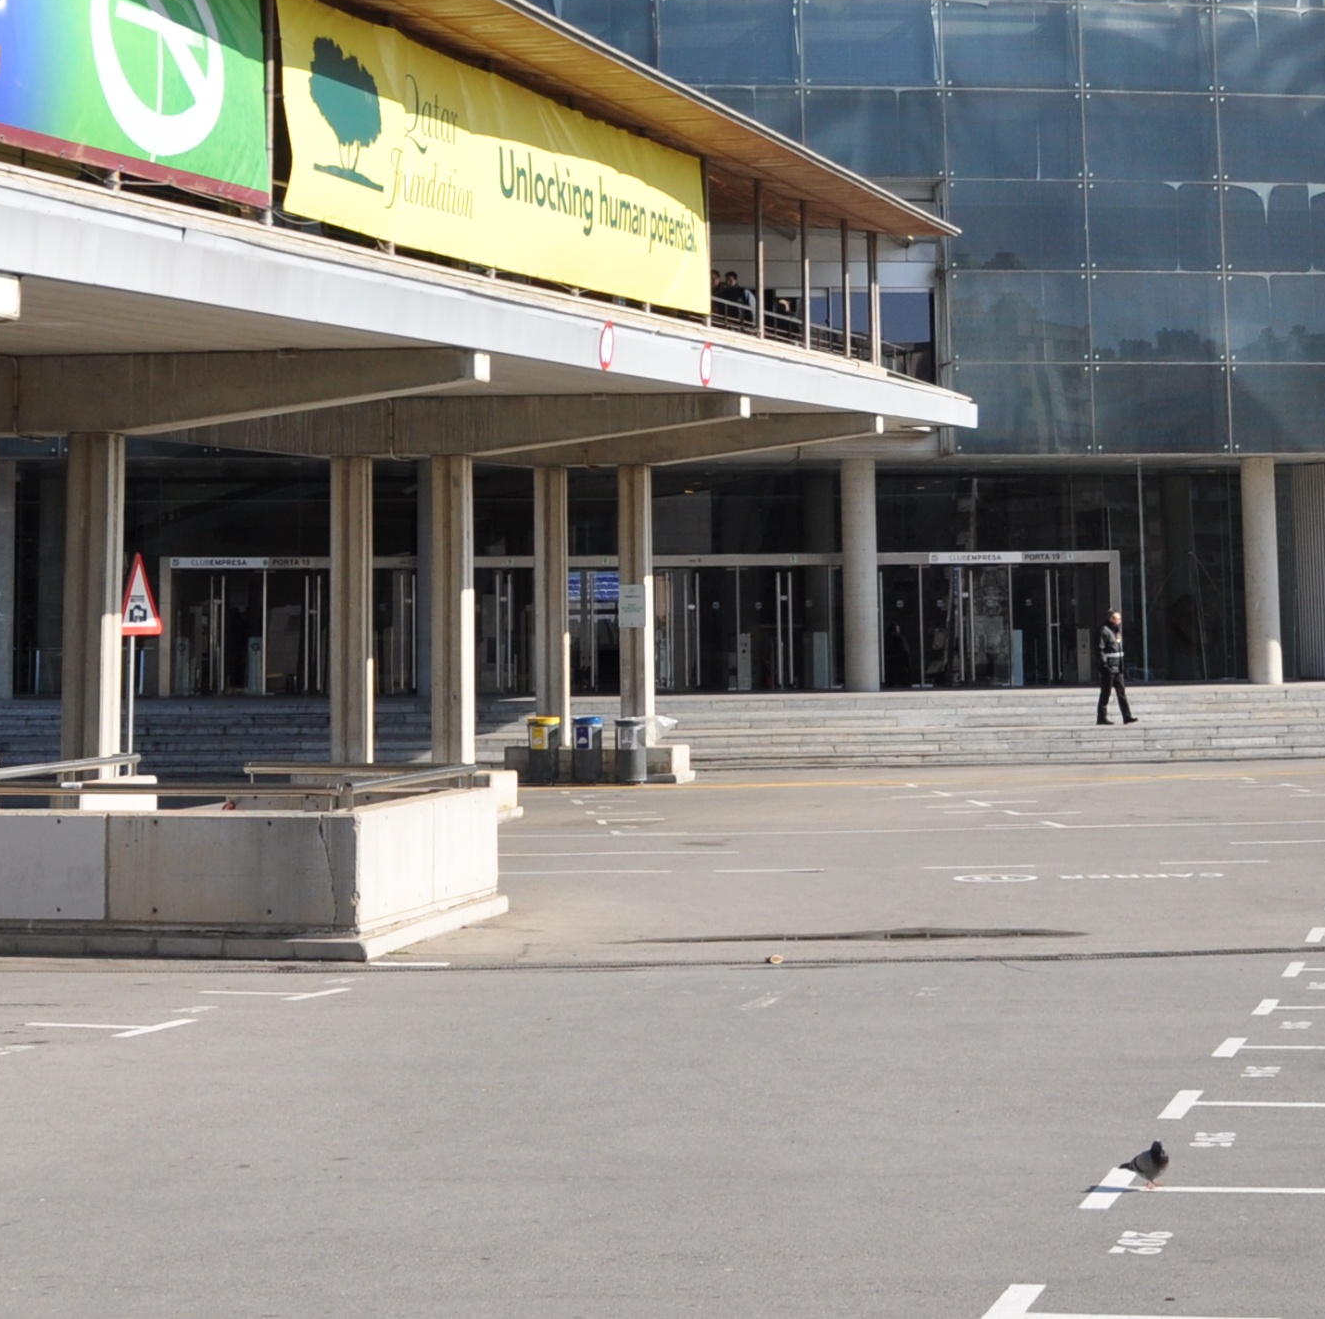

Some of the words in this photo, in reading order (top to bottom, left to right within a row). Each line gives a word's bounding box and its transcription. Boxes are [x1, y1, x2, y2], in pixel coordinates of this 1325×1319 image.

[404, 73, 458, 154] Qatar
[499, 145, 593, 236] Unlocking
[599, 175, 647, 238] human
[272, 557, 299, 566] PORTA
[1024, 553, 1050, 561] PORTA
